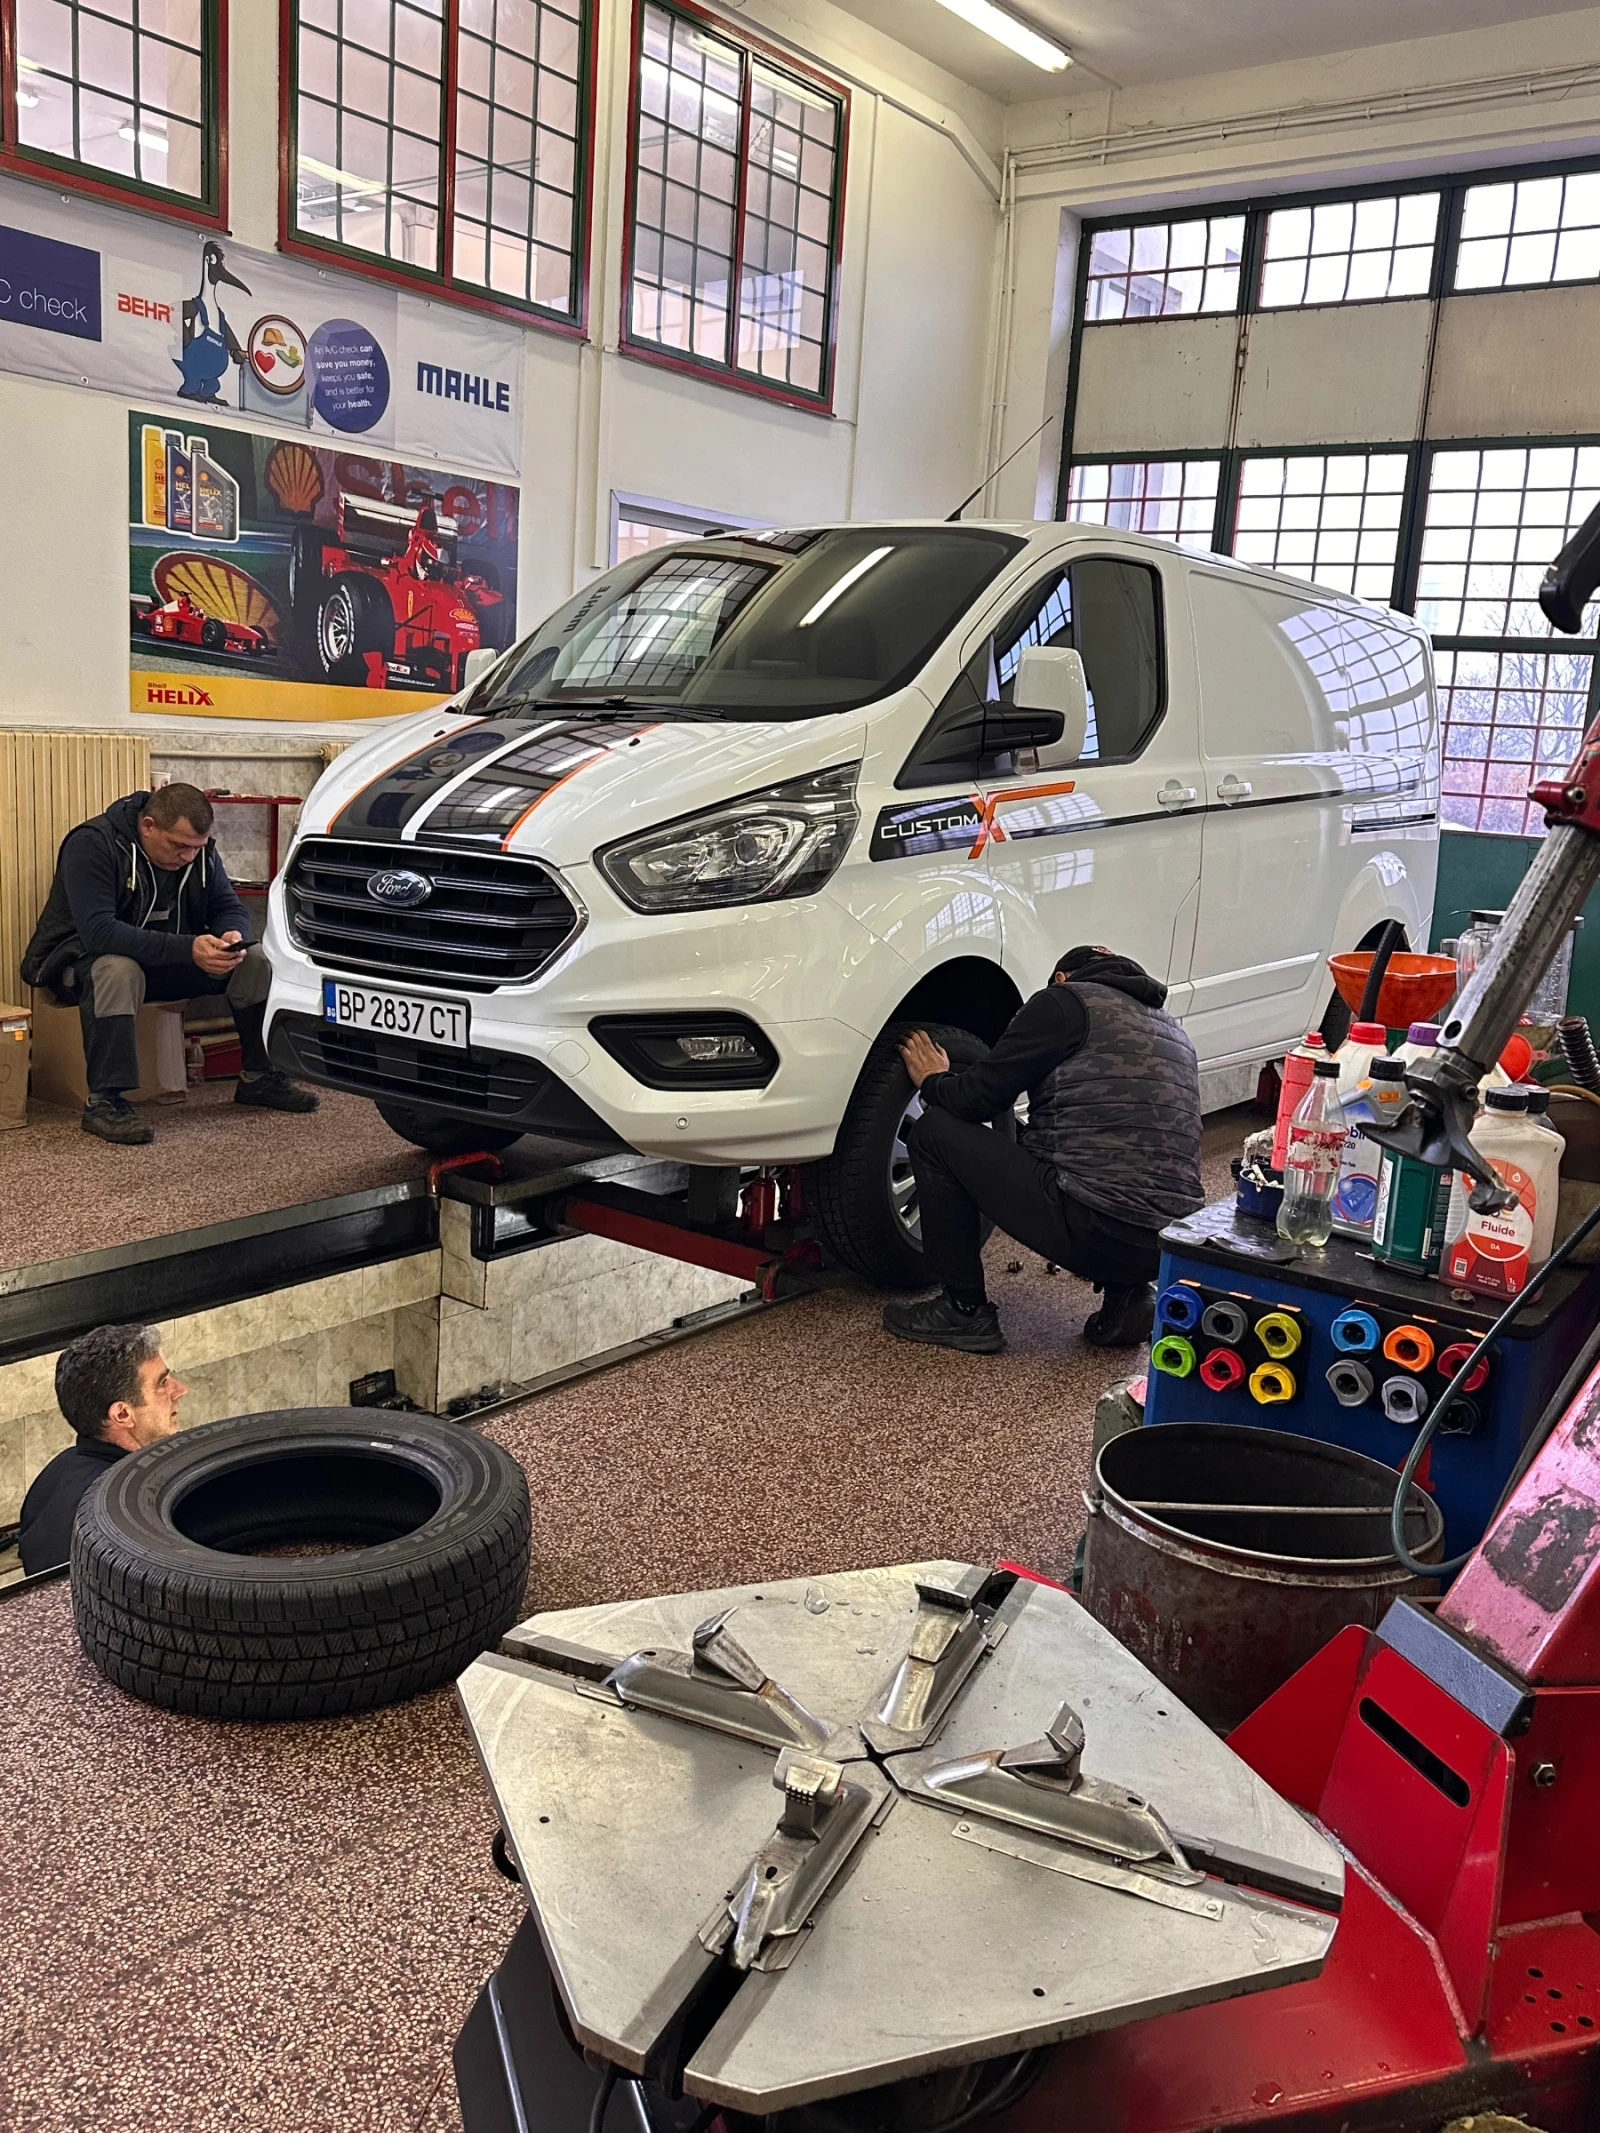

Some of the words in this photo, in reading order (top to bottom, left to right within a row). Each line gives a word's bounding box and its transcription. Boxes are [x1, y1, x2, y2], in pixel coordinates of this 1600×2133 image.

[19, 287, 88, 324] check
[117, 292, 171, 324] BEHR
[314, 346, 324, 355] An
[325, 345, 338, 354] A/C
[339, 345, 359, 354] check
[360, 345, 373, 353] can
[334, 361, 348, 370] you
[349, 359, 376, 369] money,
[321, 374, 342, 383] keeps
[343, 374, 355, 383] you
[356, 371, 374, 381] safe,
[325, 387, 338, 396] and
[339, 387, 345, 395] is
[346, 385, 365, 395] better
[366, 384, 375, 393] for
[417, 361, 509, 413] MAHLE
[332, 402, 346, 411] your
[347, 399, 372, 408] health.
[147, 688, 214, 706] HELIX
[881, 814, 979, 839] CUSTOM
[376, 873, 413, 898] Ford
[327, 1006, 336, 1017] BG
[339, 989, 365, 1023] BP
[370, 995, 425, 1035] 2837
[430, 1006, 461, 1042] CT
[1481, 1220, 1515, 1237] Fluide
[1490, 1243, 1501, 1251] DA
